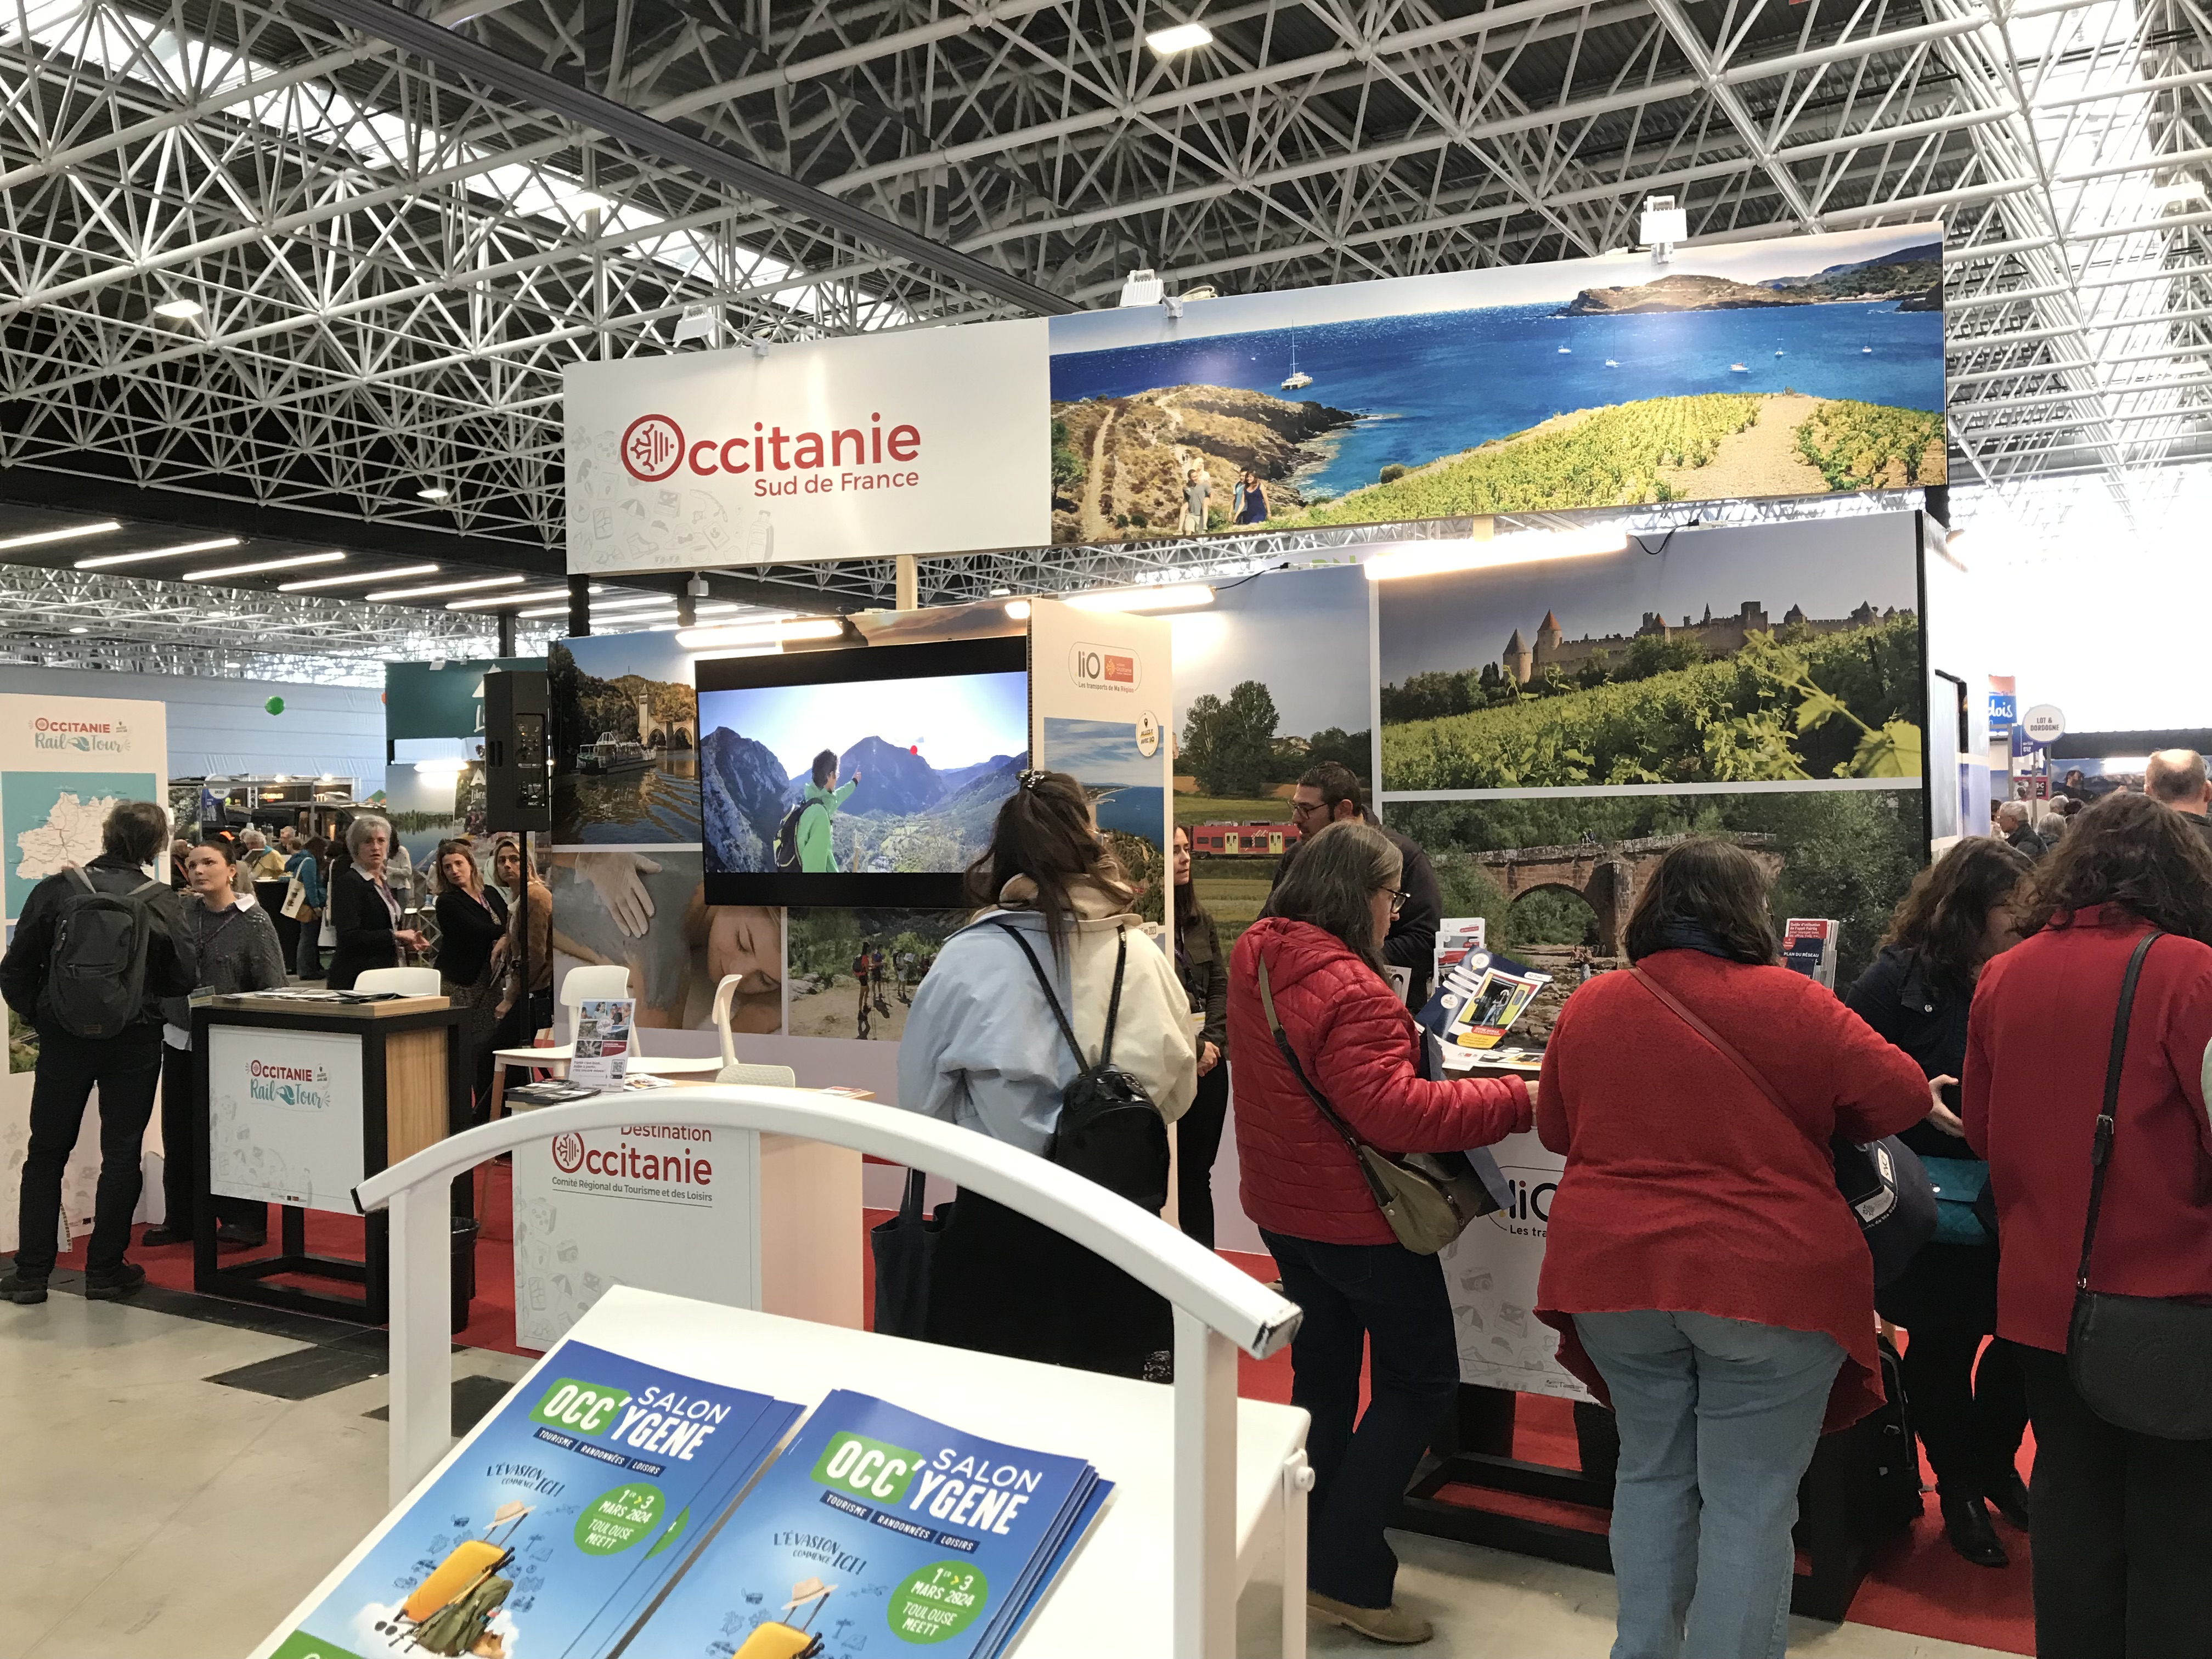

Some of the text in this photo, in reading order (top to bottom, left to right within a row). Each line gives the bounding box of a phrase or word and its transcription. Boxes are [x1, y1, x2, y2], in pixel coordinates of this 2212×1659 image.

[620, 412, 921, 482] Occitanie
[754, 471, 919, 497] Sud de France
[1087, 682, 1108, 691] transports
[35, 718, 111, 733] OCCITANIE
[35, 732, 124, 753] Rail Tour
[251, 1060, 312, 1081] OCCITANIE
[251, 1078, 322, 1108] Rail Tour
[621, 1126, 712, 1142] Destination
[552, 1132, 712, 1185] Occitanie
[552, 1176, 712, 1201] Comité Régional du Tourisme et des Loisirs
[1510, 1224, 1528, 1235] Les
[638, 1386, 731, 1424] SALON
[539, 1430, 660, 1475] TOURISME RANDONNÉES LOISIRS
[487, 1462, 545, 1481] L'ÉVASION
[933, 1448, 1043, 1493] SALON
[501, 1478, 534, 1489] COMMENCE
[598, 1500, 652, 1524] MARS 2024
[641, 1496, 654, 1509] 3
[588, 1519, 634, 1539] TOULOUSE
[827, 1494, 974, 1551] TOURISME RANDONNÉES LOISIRS
[585, 1533, 617, 1549] MEETT
[774, 1529, 840, 1555] L'ÉVASION
[793, 1549, 831, 1564] COMMENCE
[911, 1581, 975, 1607] MARS 2024
[959, 1575, 974, 1592] 3
[902, 1601, 957, 1627] TOULOUSE
[902, 1618, 939, 1637] MEETT
